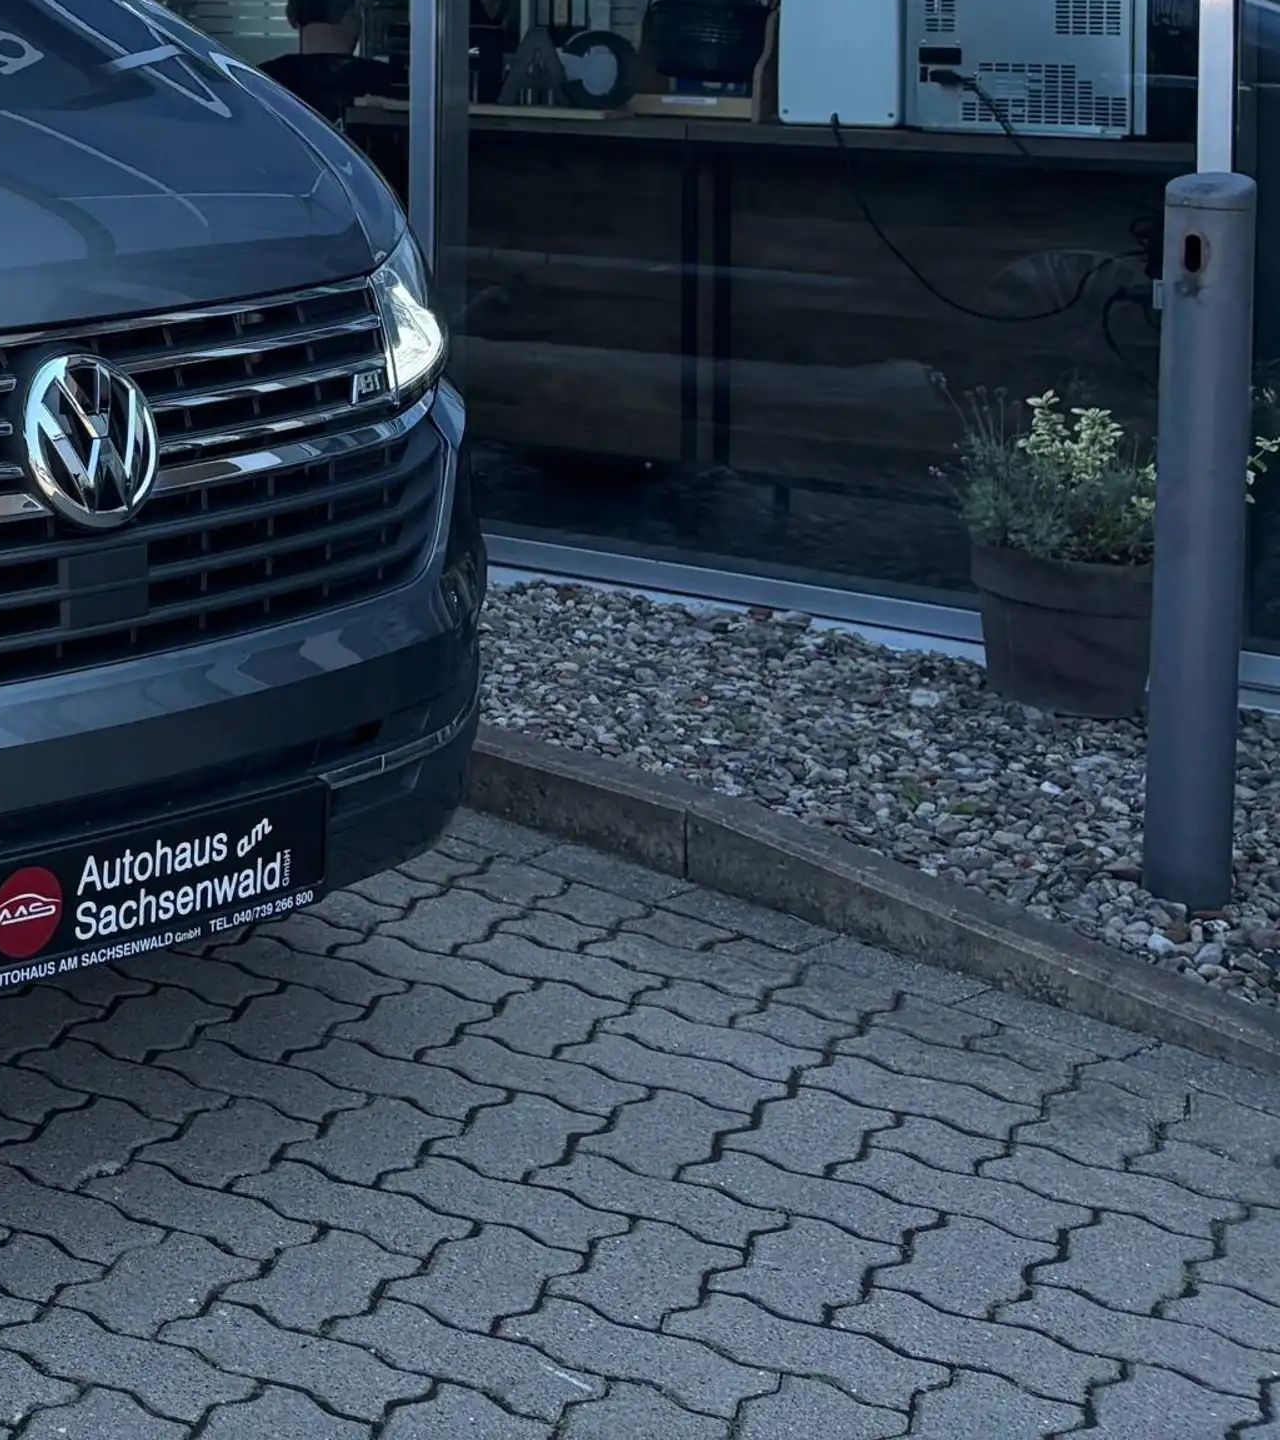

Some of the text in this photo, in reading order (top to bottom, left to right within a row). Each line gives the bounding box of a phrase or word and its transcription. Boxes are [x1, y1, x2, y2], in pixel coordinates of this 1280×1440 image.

[74, 851, 282, 941] Sachsenwald
[76, 817, 273, 896] Autohaus am
[282, 849, 291, 887] GmbH
[58, 955, 78, 973] AM
[81, 932, 173, 967] SACHSENWALD
[174, 926, 201, 943] GmbH
[274, 896, 294, 913] 266
[295, 890, 314, 906] 800
